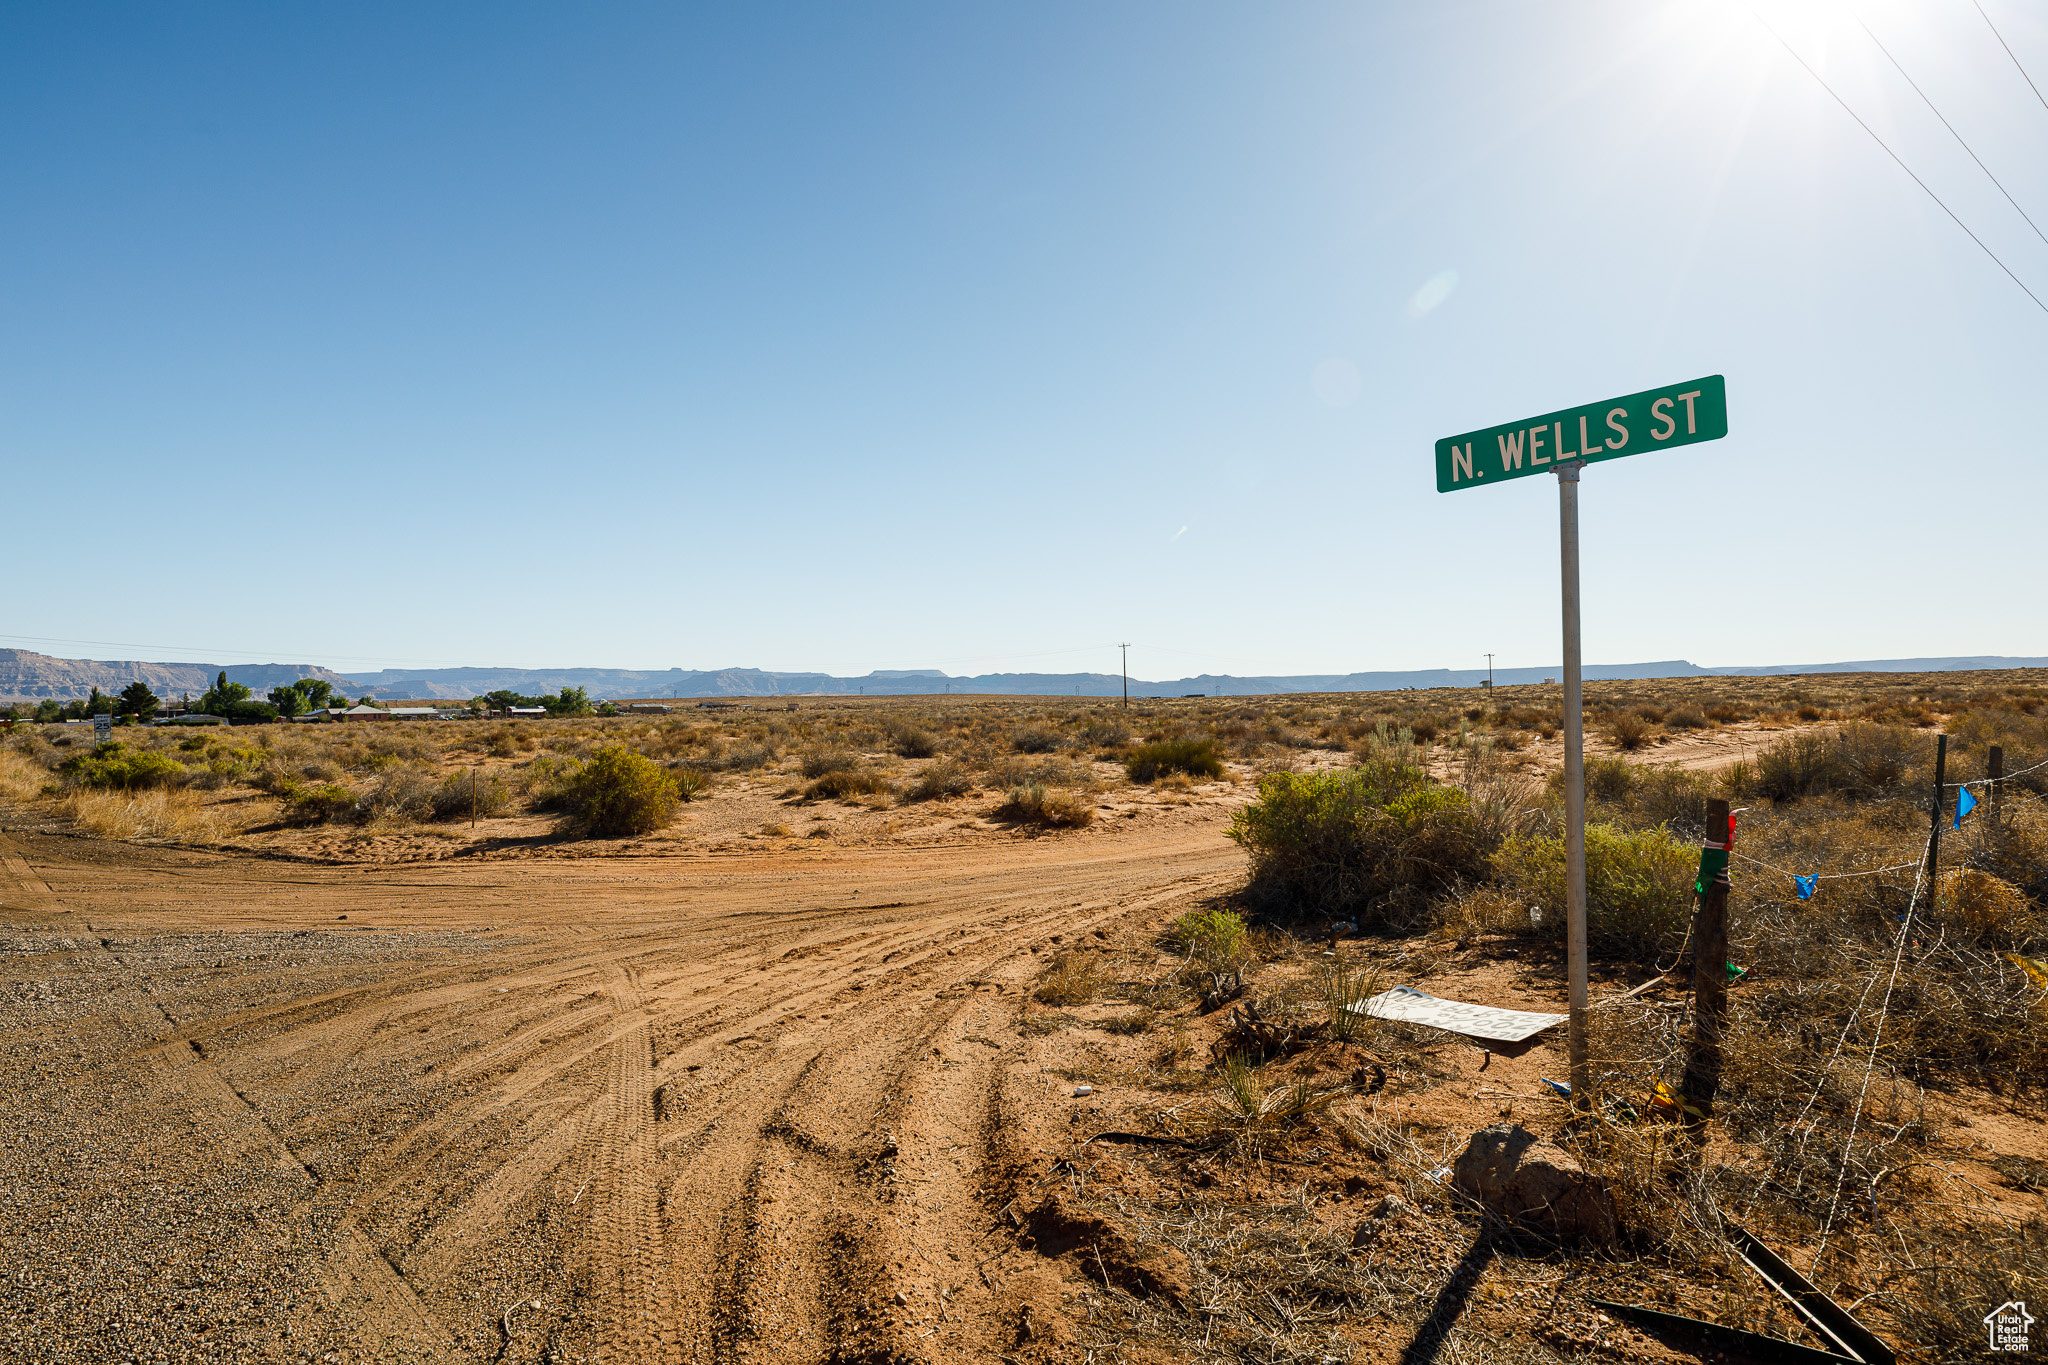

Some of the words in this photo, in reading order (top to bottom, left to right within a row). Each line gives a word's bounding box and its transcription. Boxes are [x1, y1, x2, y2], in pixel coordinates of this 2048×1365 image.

[1451, 442, 1484, 483] N.
[1497, 407, 1629, 472] WELLS
[1650, 390, 1702, 441] ST
